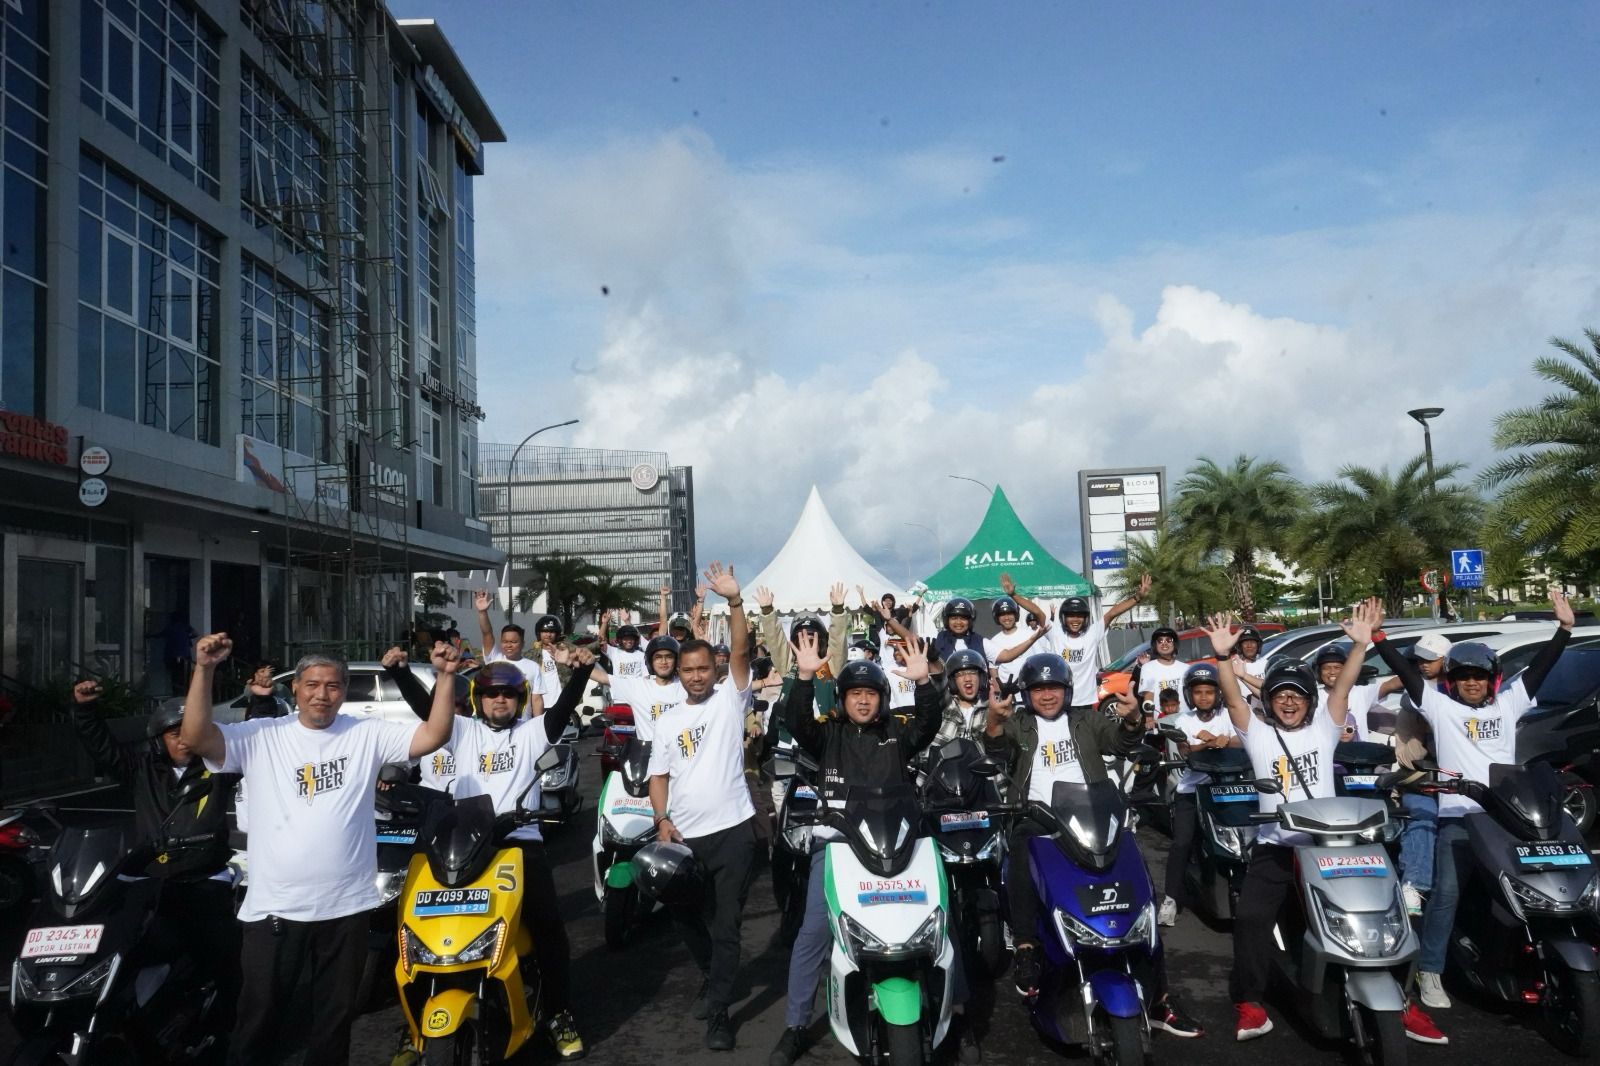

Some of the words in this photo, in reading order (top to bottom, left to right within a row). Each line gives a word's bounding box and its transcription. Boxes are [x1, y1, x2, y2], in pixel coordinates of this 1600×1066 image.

[965, 550, 1034, 566] KALLA
[1463, 718, 1501, 731] SILENT
[479, 745, 516, 765] SILENT
[296, 757, 348, 783] SILENT
[479, 757, 514, 773] RIDER
[299, 771, 344, 796] RIDER
[1516, 846, 1530, 856] DP
[1536, 845, 1564, 855] 5963
[495, 864, 517, 892] 5
[860, 881, 873, 891] DD
[876, 880, 903, 891] 5575
[907, 879, 921, 889] XX
[417, 892, 431, 904] DD
[436, 890, 464, 902] 4099
[1091, 903, 1130, 912] UNITED
[28, 932, 43, 944] DD
[46, 929, 78, 942] 2345
[83, 928, 100, 940] XX
[60, 943, 91, 951] LISTRIK
